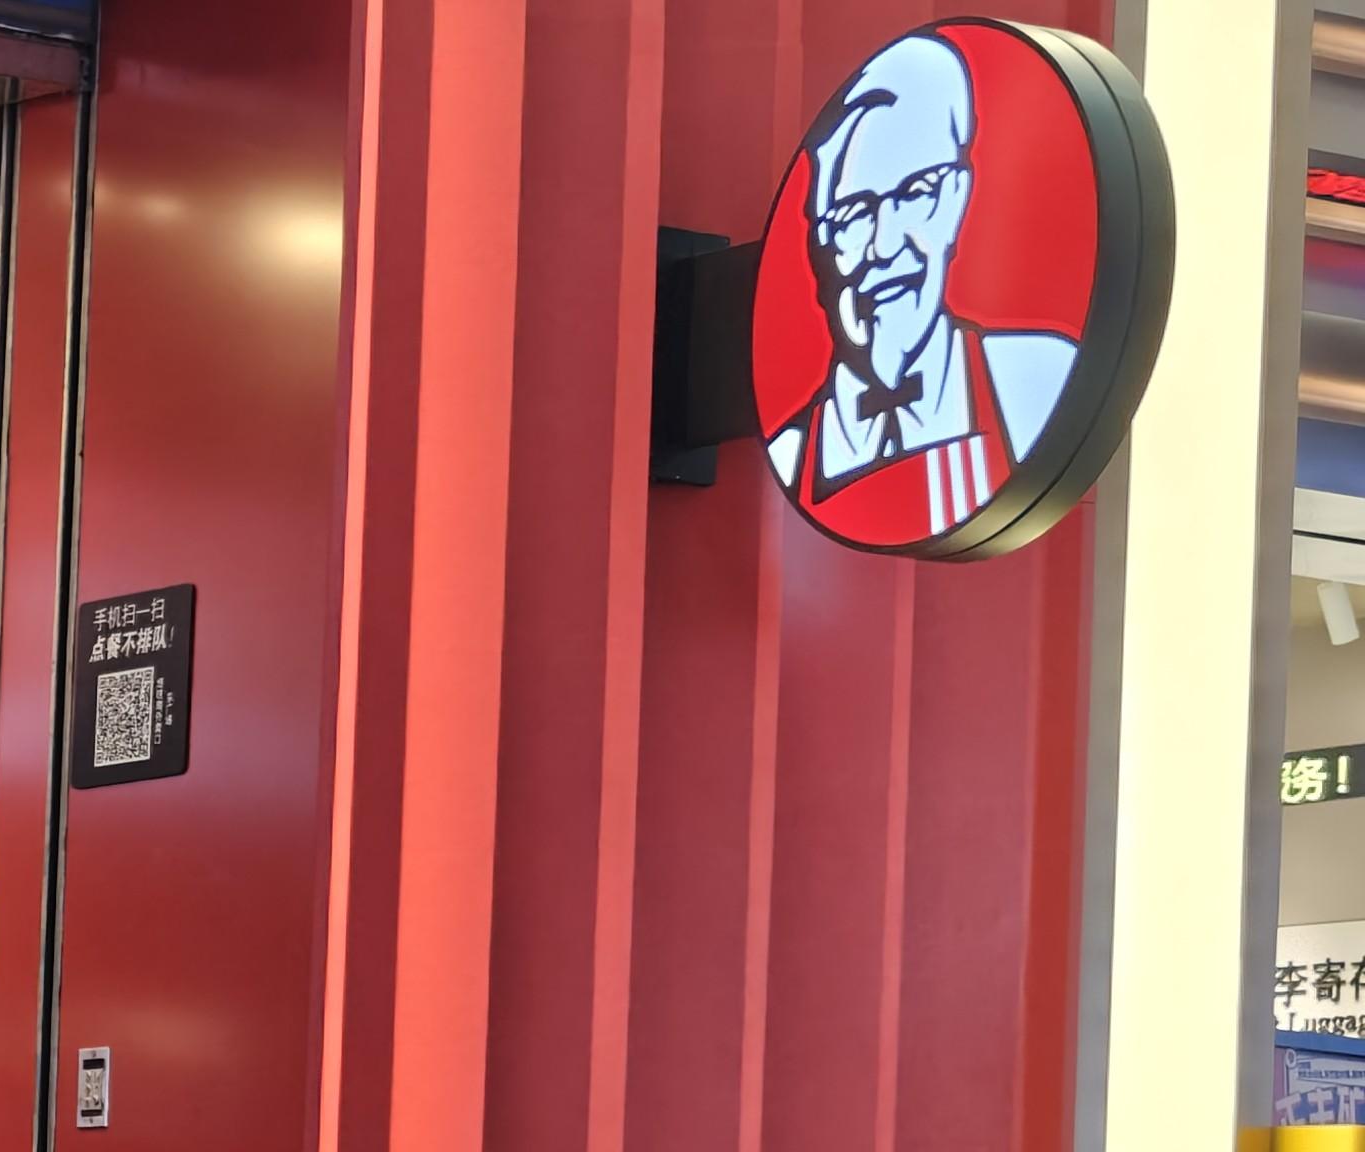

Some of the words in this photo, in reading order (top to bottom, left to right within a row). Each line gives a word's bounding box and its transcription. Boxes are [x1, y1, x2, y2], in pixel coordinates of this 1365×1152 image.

[93, 598, 165, 631] 手机扫一扫
